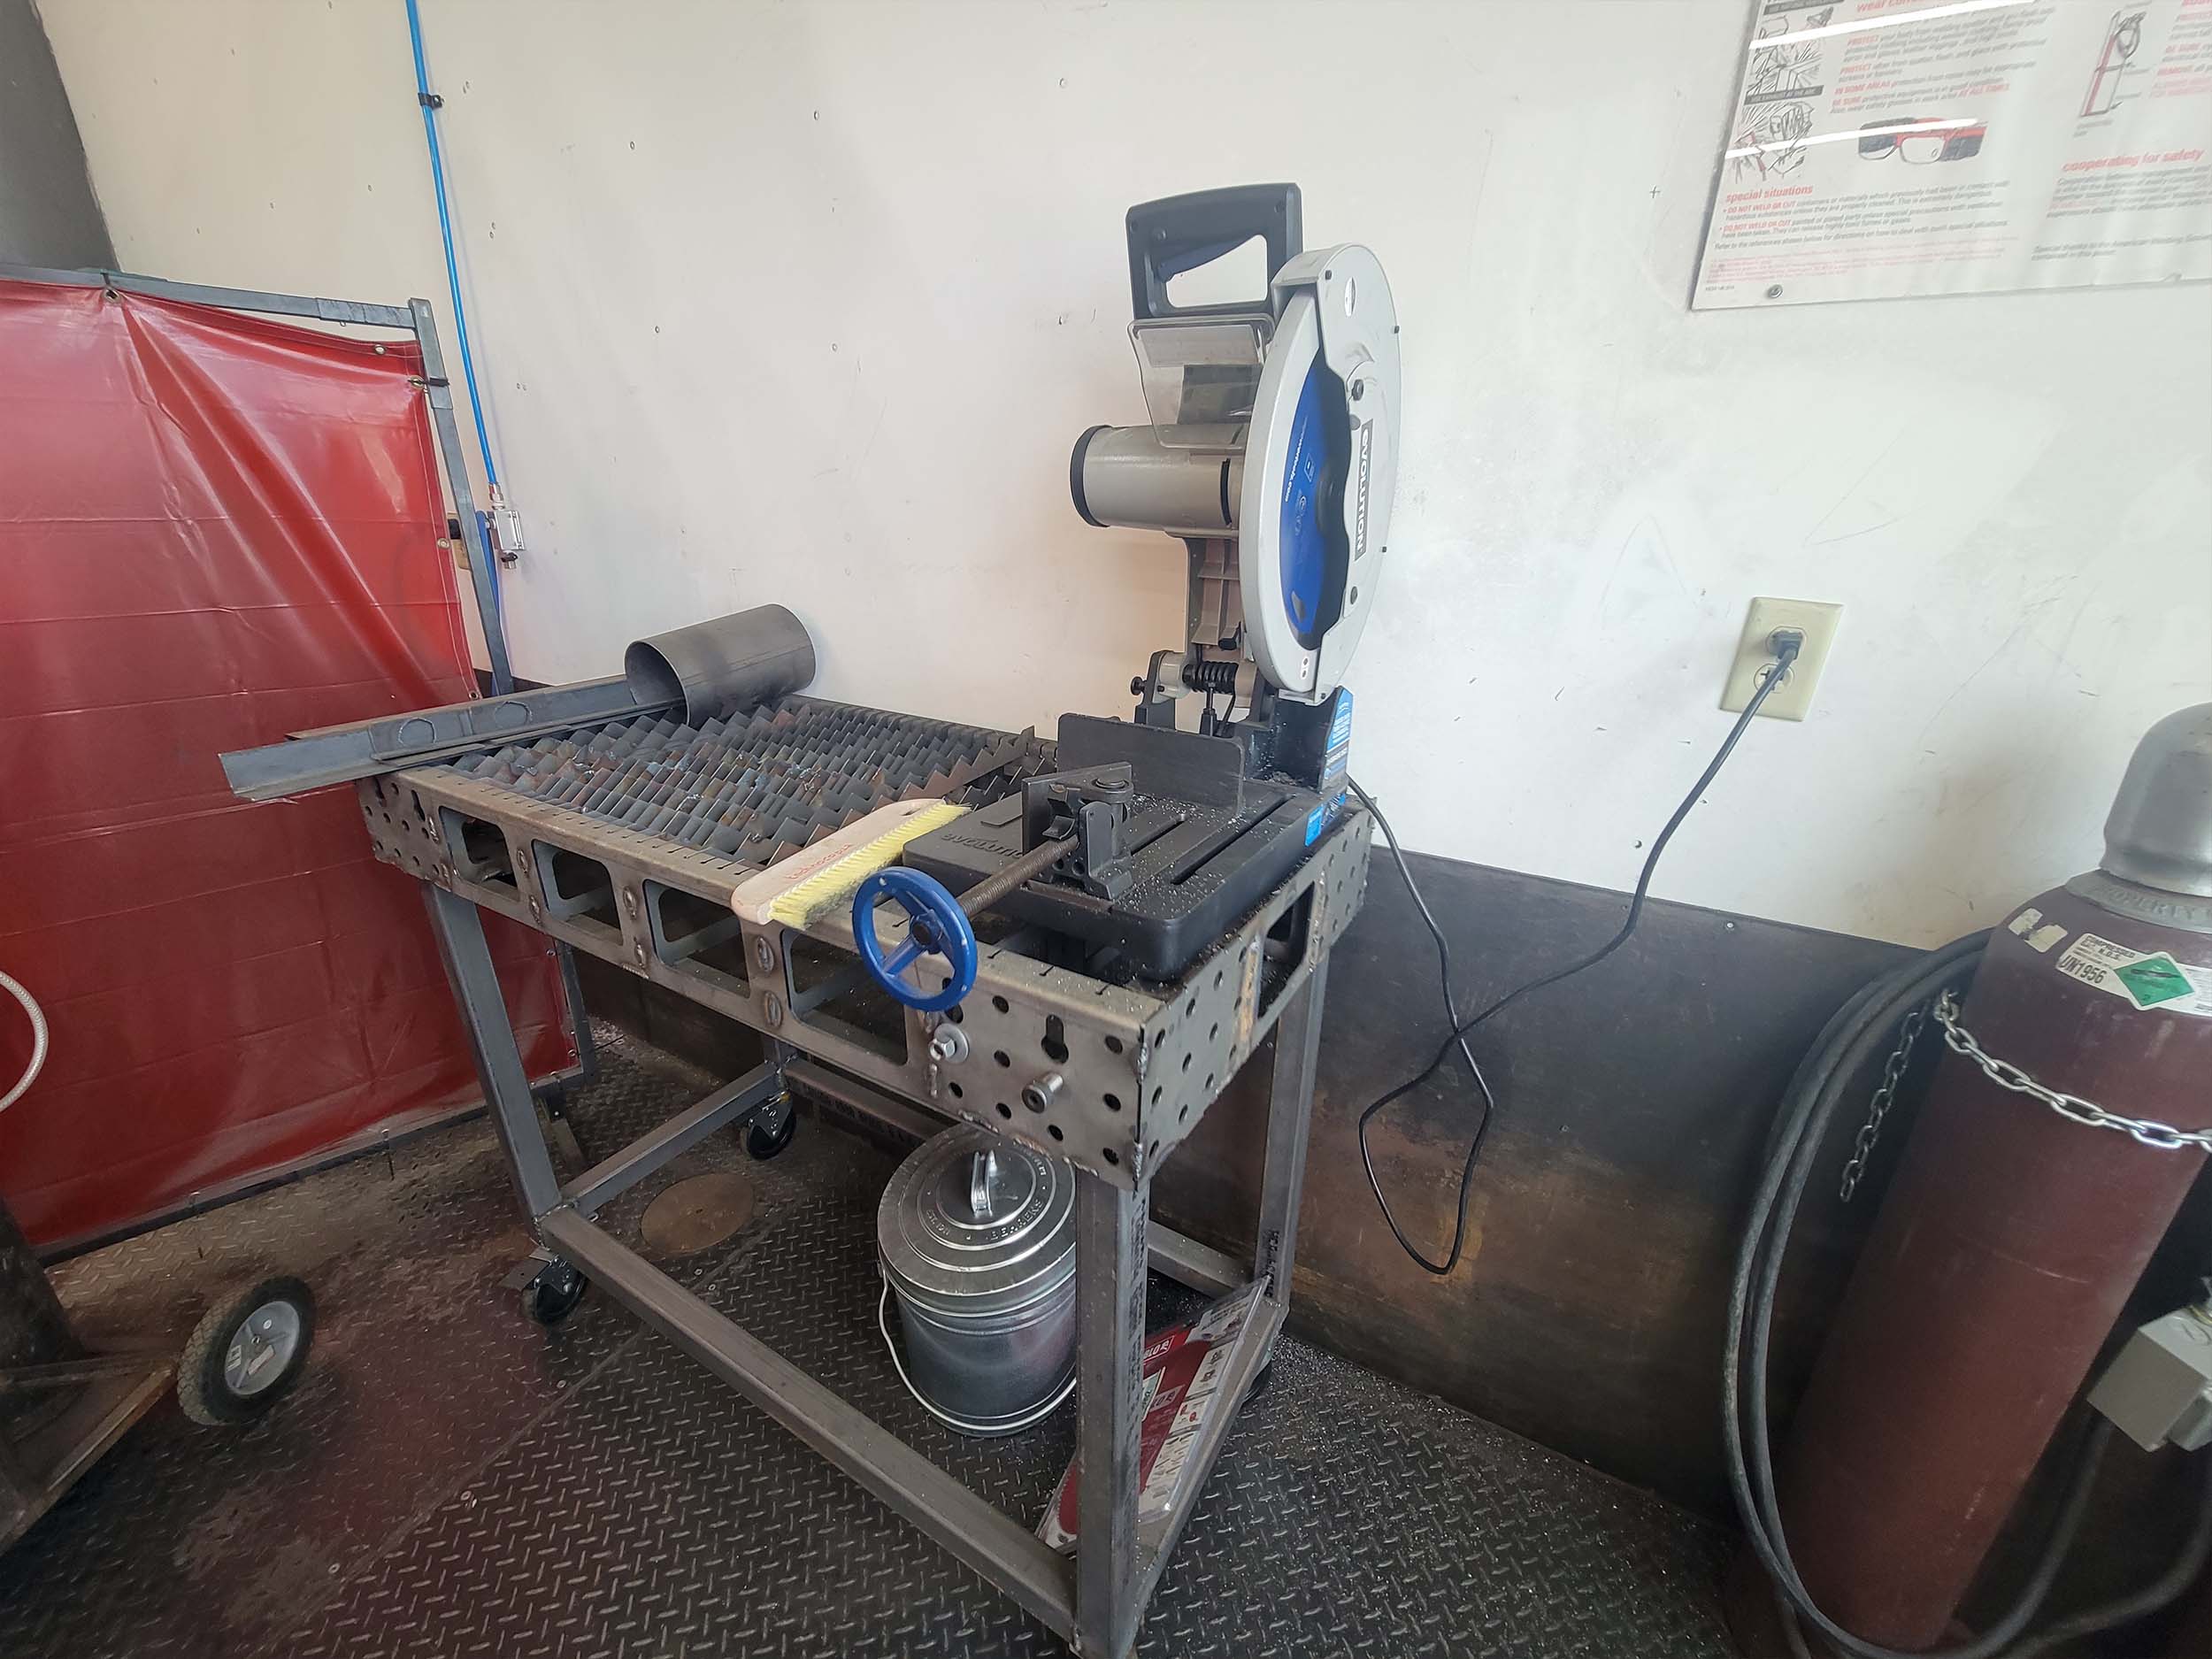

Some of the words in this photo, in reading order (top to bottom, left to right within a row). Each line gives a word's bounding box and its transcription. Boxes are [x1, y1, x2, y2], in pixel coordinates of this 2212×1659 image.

[2141, 151, 2161, 164] for
[2162, 149, 2205, 162] safety
[1726, 188, 1763, 204] special
[1763, 185, 1813, 199] situations
[2059, 955, 2108, 984] UN1956
